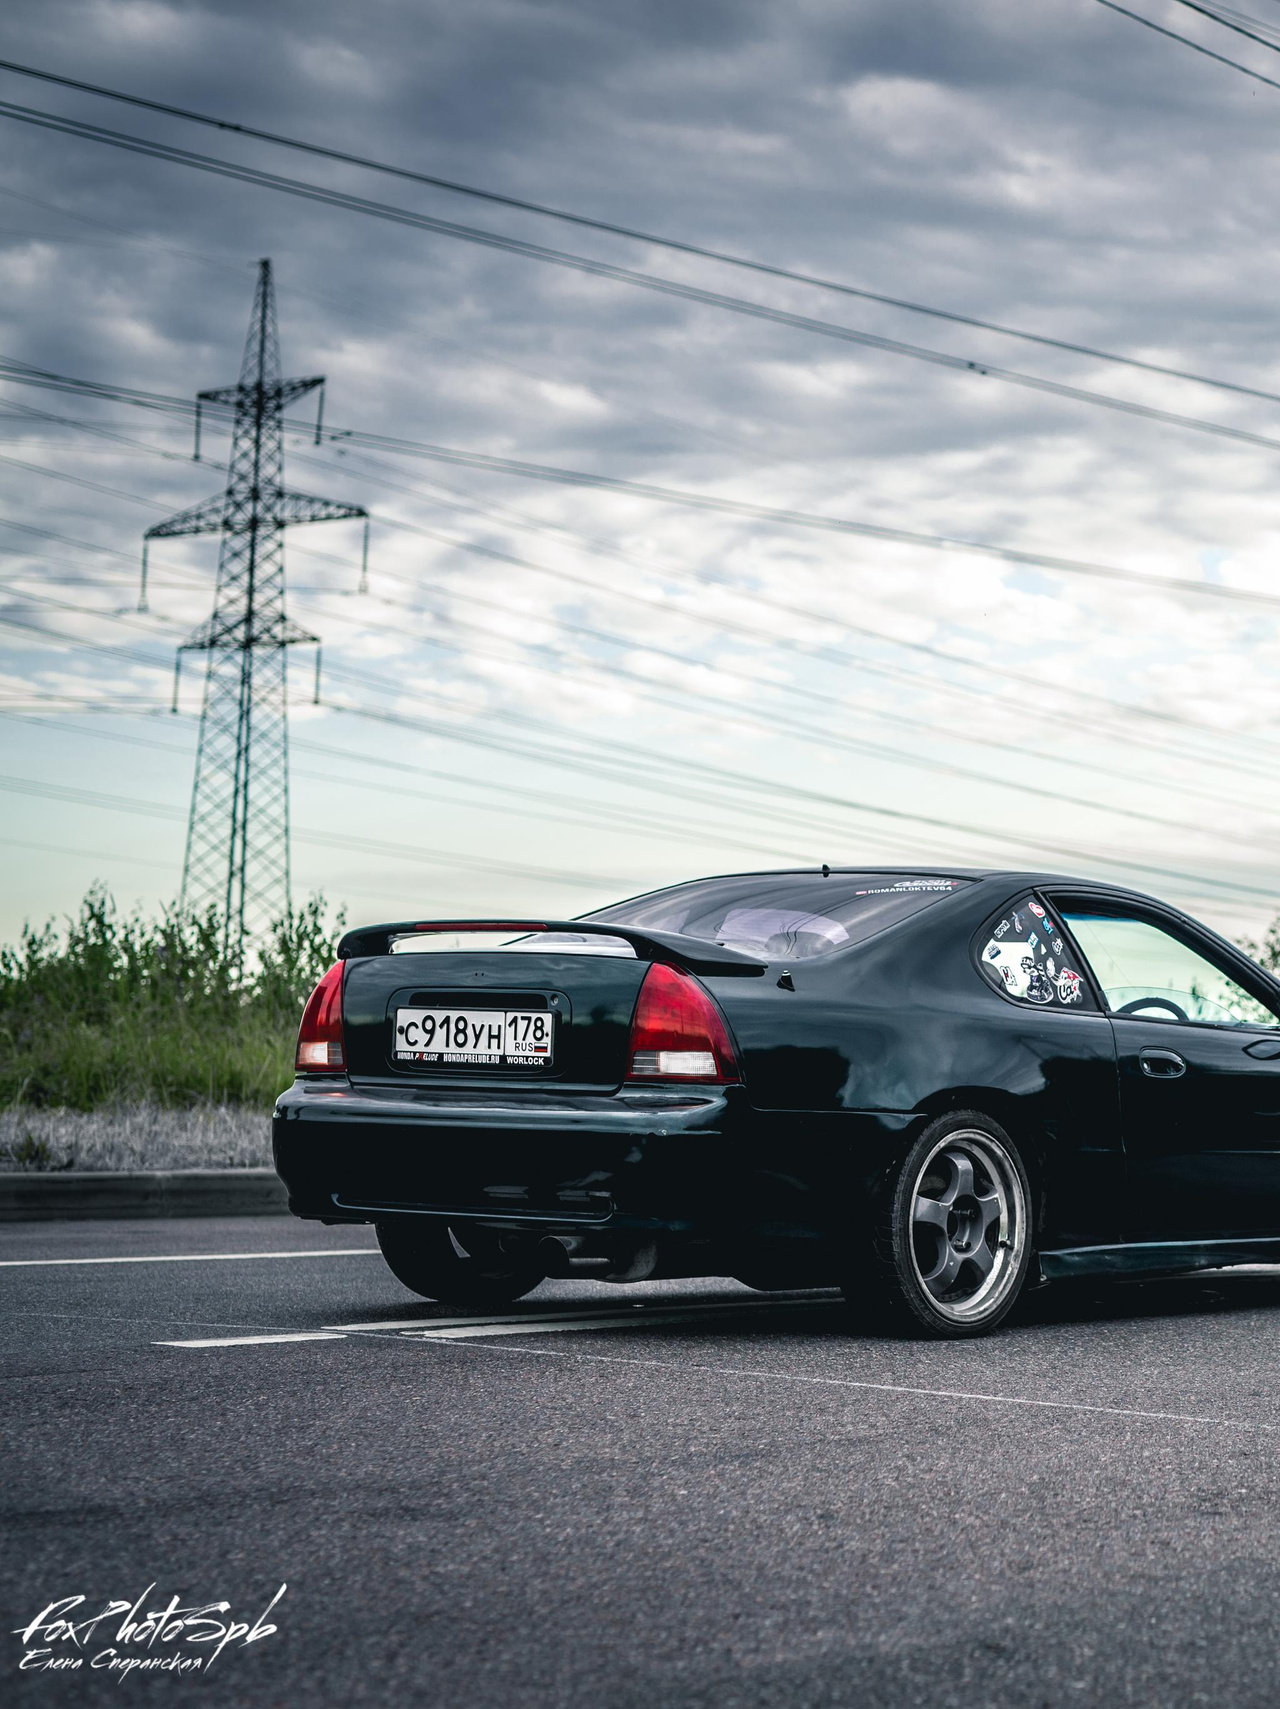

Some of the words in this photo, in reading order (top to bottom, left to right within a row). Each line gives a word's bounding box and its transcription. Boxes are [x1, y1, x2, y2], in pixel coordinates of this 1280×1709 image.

[405, 1015, 501, 1049] С918УН
[508, 1016, 545, 1041] 178
[514, 1042, 534, 1052] RUS
[397, 1052, 414, 1060] HONDA
[415, 1053, 439, 1062] PRELUDE
[443, 1054, 500, 1064] HONDAPRELUDE.RU
[506, 1057, 545, 1066] WORLOCK
